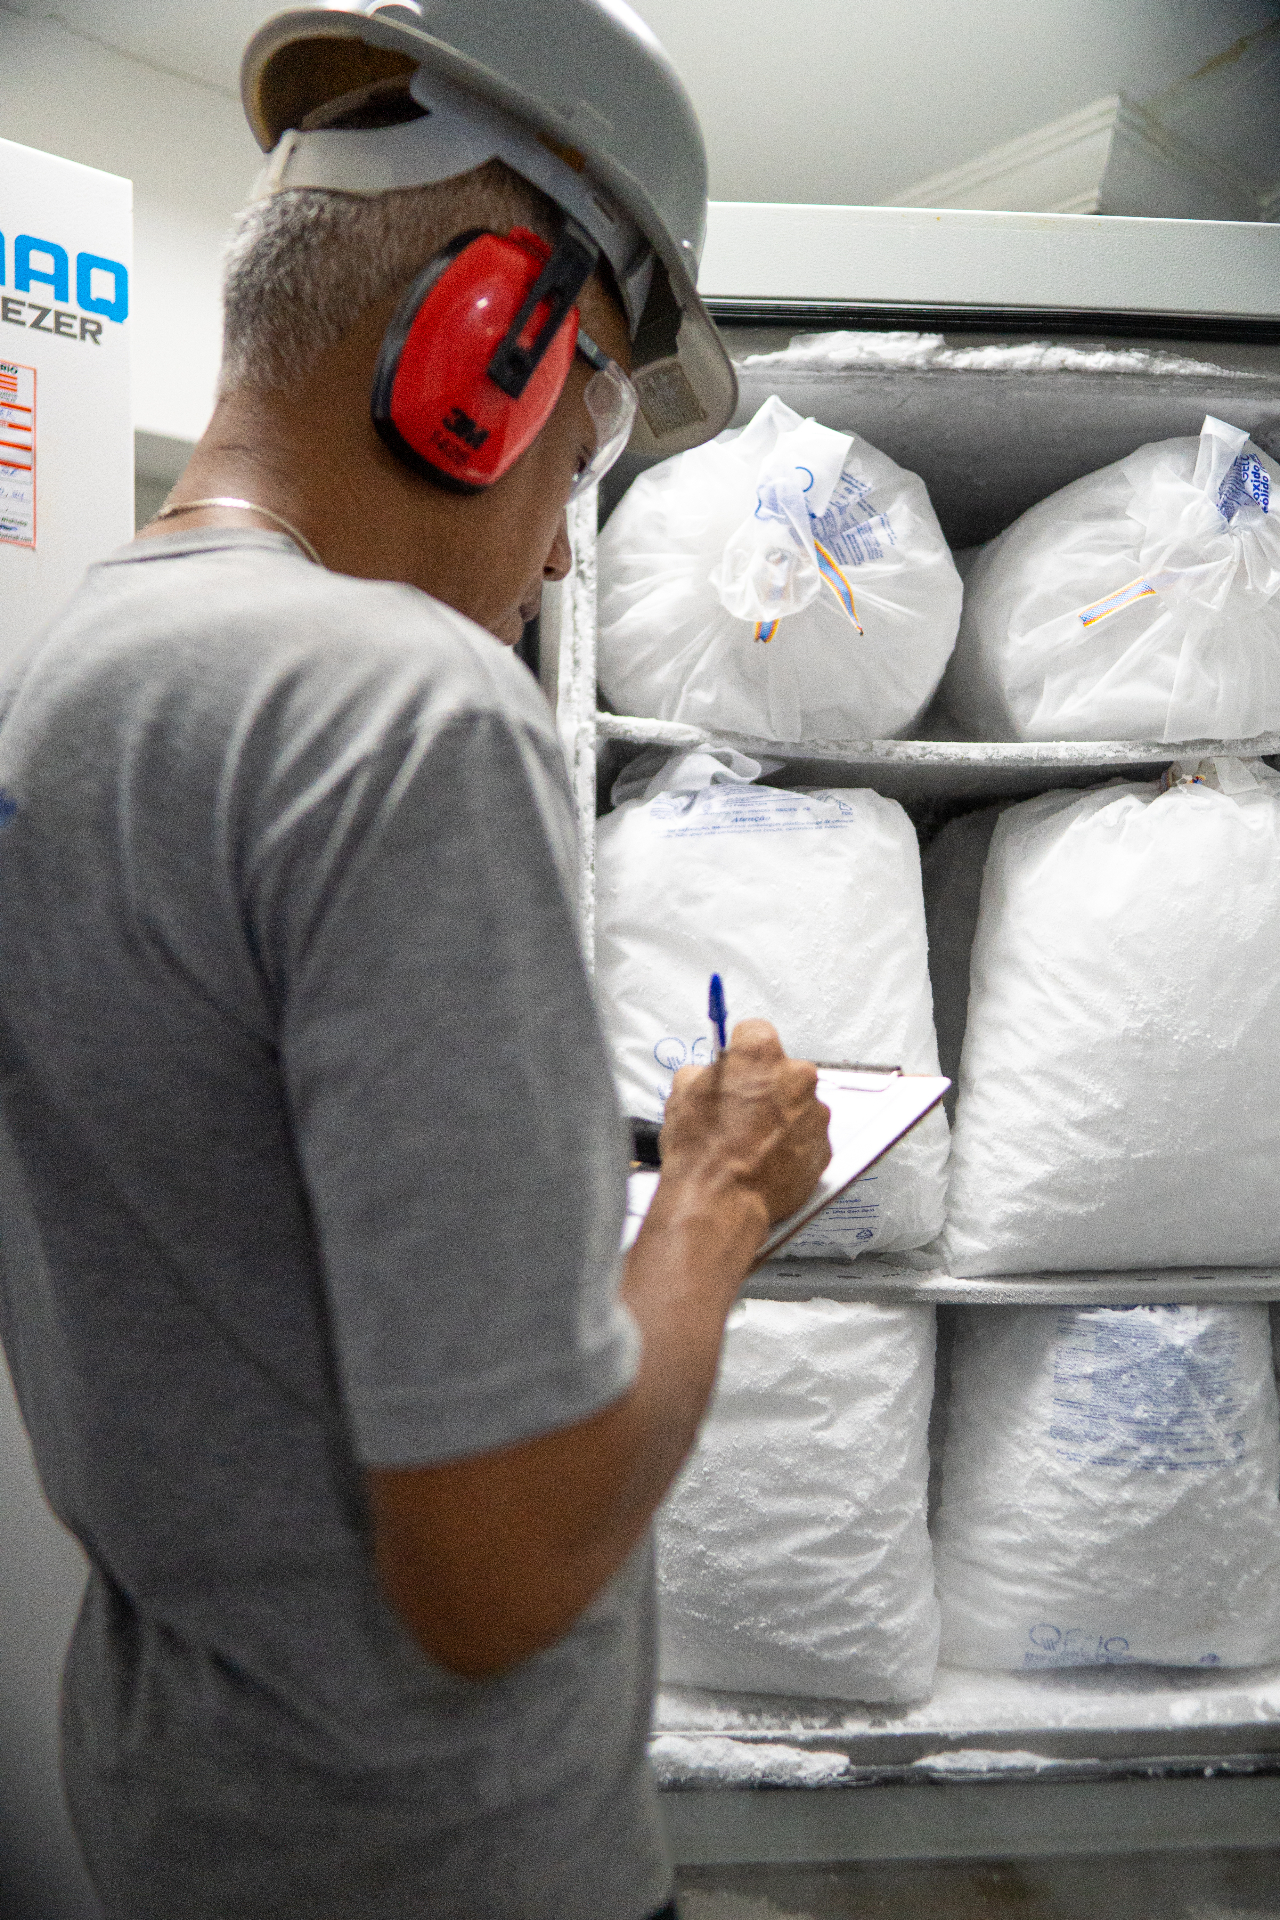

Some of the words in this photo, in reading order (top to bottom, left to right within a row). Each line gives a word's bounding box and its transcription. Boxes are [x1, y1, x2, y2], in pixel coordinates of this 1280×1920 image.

[0, 230, 129, 324] AQ
[1, 296, 103, 345] EZER
[443, 408, 490, 449] 3M
